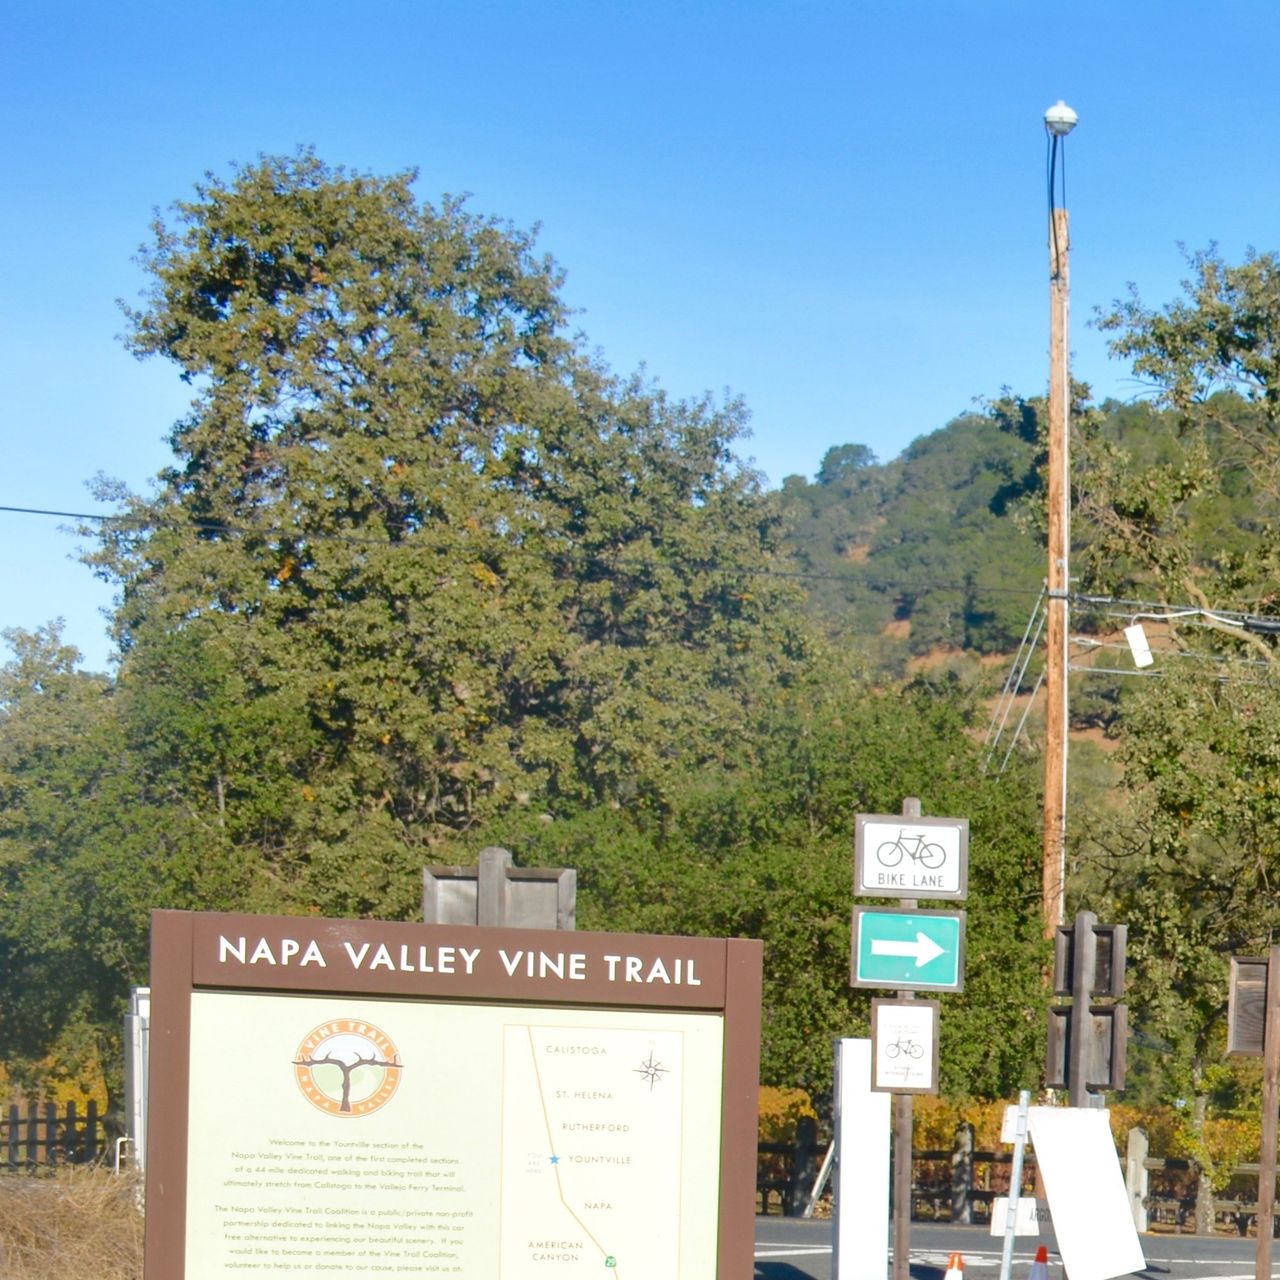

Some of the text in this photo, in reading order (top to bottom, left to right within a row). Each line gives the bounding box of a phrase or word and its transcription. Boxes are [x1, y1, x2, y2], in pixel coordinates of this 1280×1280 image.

[878, 873, 945, 888] BIKE LANE
[218, 934, 702, 987] NAPA VALLEY VINE TRAIL
[304, 1021, 391, 1052] VINE TRAIL
[545, 1044, 608, 1055] CALISTOGA
[555, 1090, 614, 1100] ST. HELENA
[561, 1122, 630, 1132] RUTHERFORD
[568, 1155, 632, 1165] YOUNTVILLE
[584, 1202, 613, 1210] NAPA
[1029, 1207, 1052, 1222] ARGO
[527, 1241, 584, 1249] AMERICAN
[531, 1252, 580, 1262] CANYON
